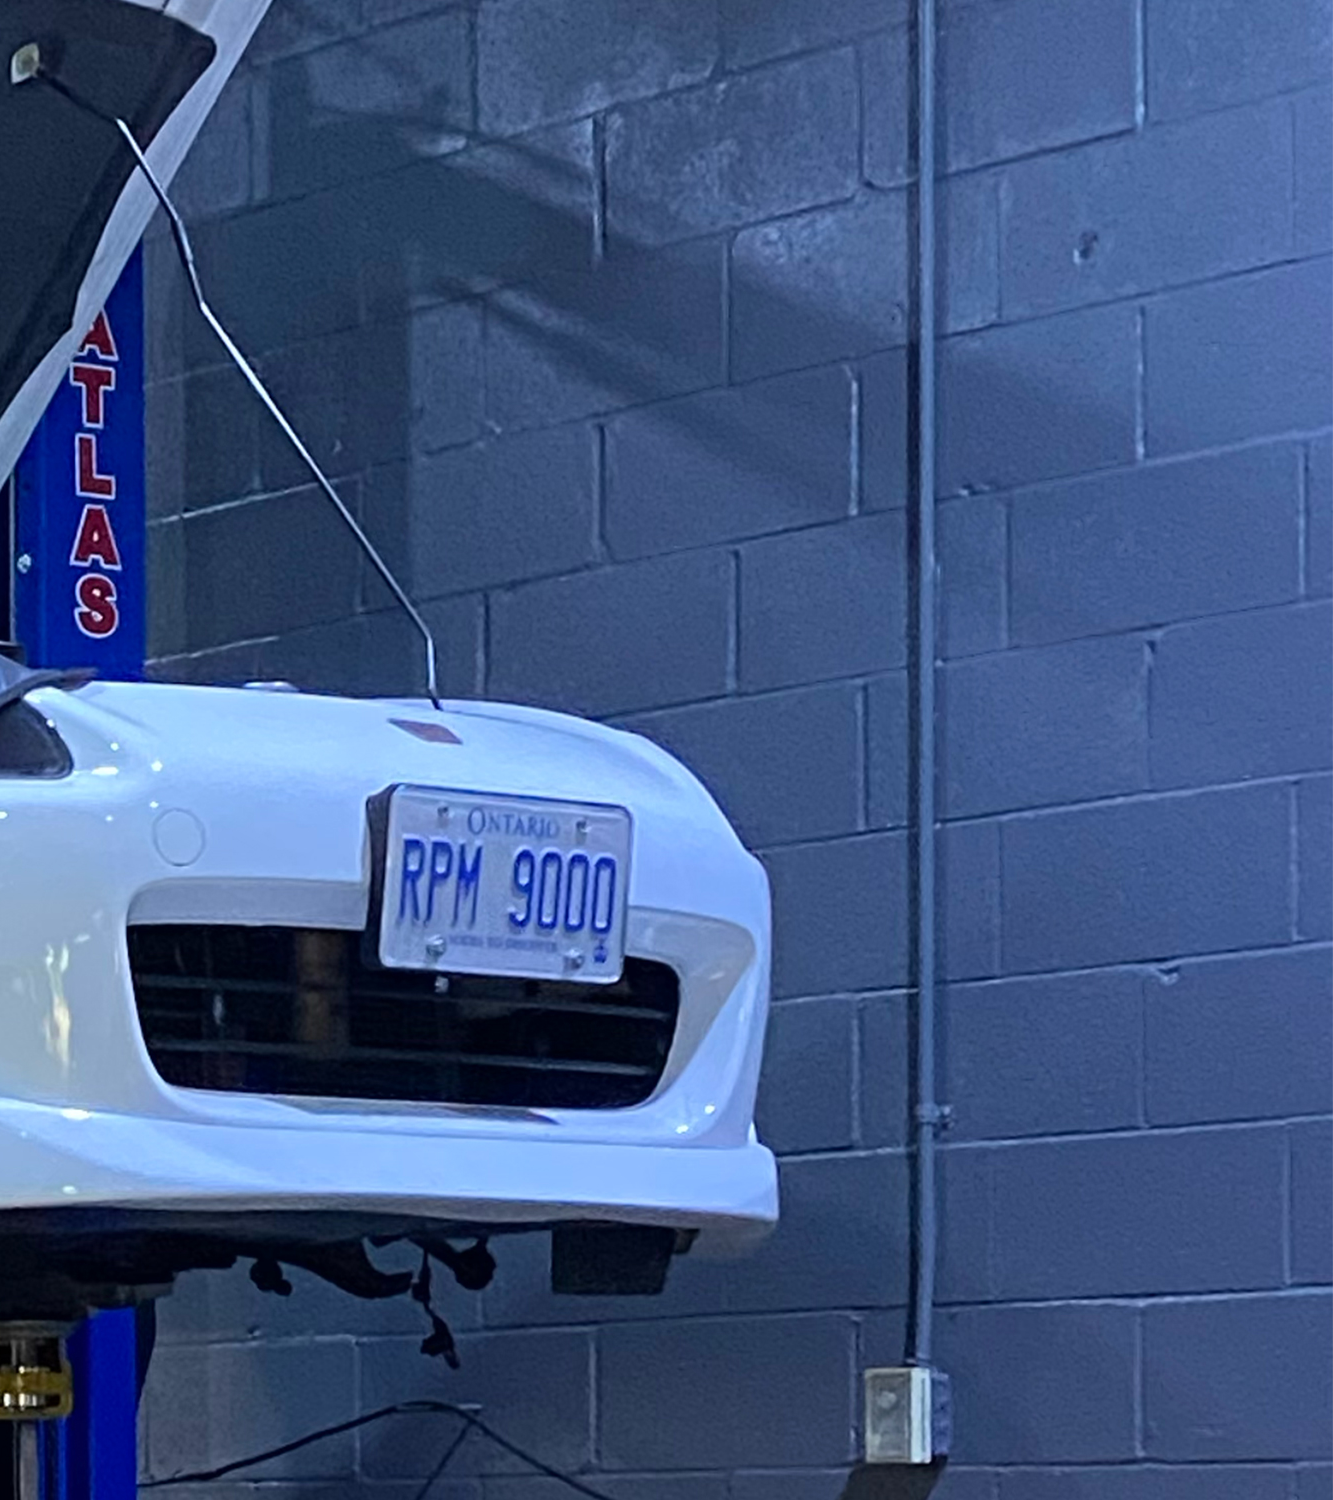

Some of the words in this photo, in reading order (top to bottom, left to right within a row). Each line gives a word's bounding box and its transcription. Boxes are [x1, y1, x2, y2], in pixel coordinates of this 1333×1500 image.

[69, 307, 122, 638] ATLAS
[399, 838, 482, 927] RPM
[509, 849, 616, 934] 9000
